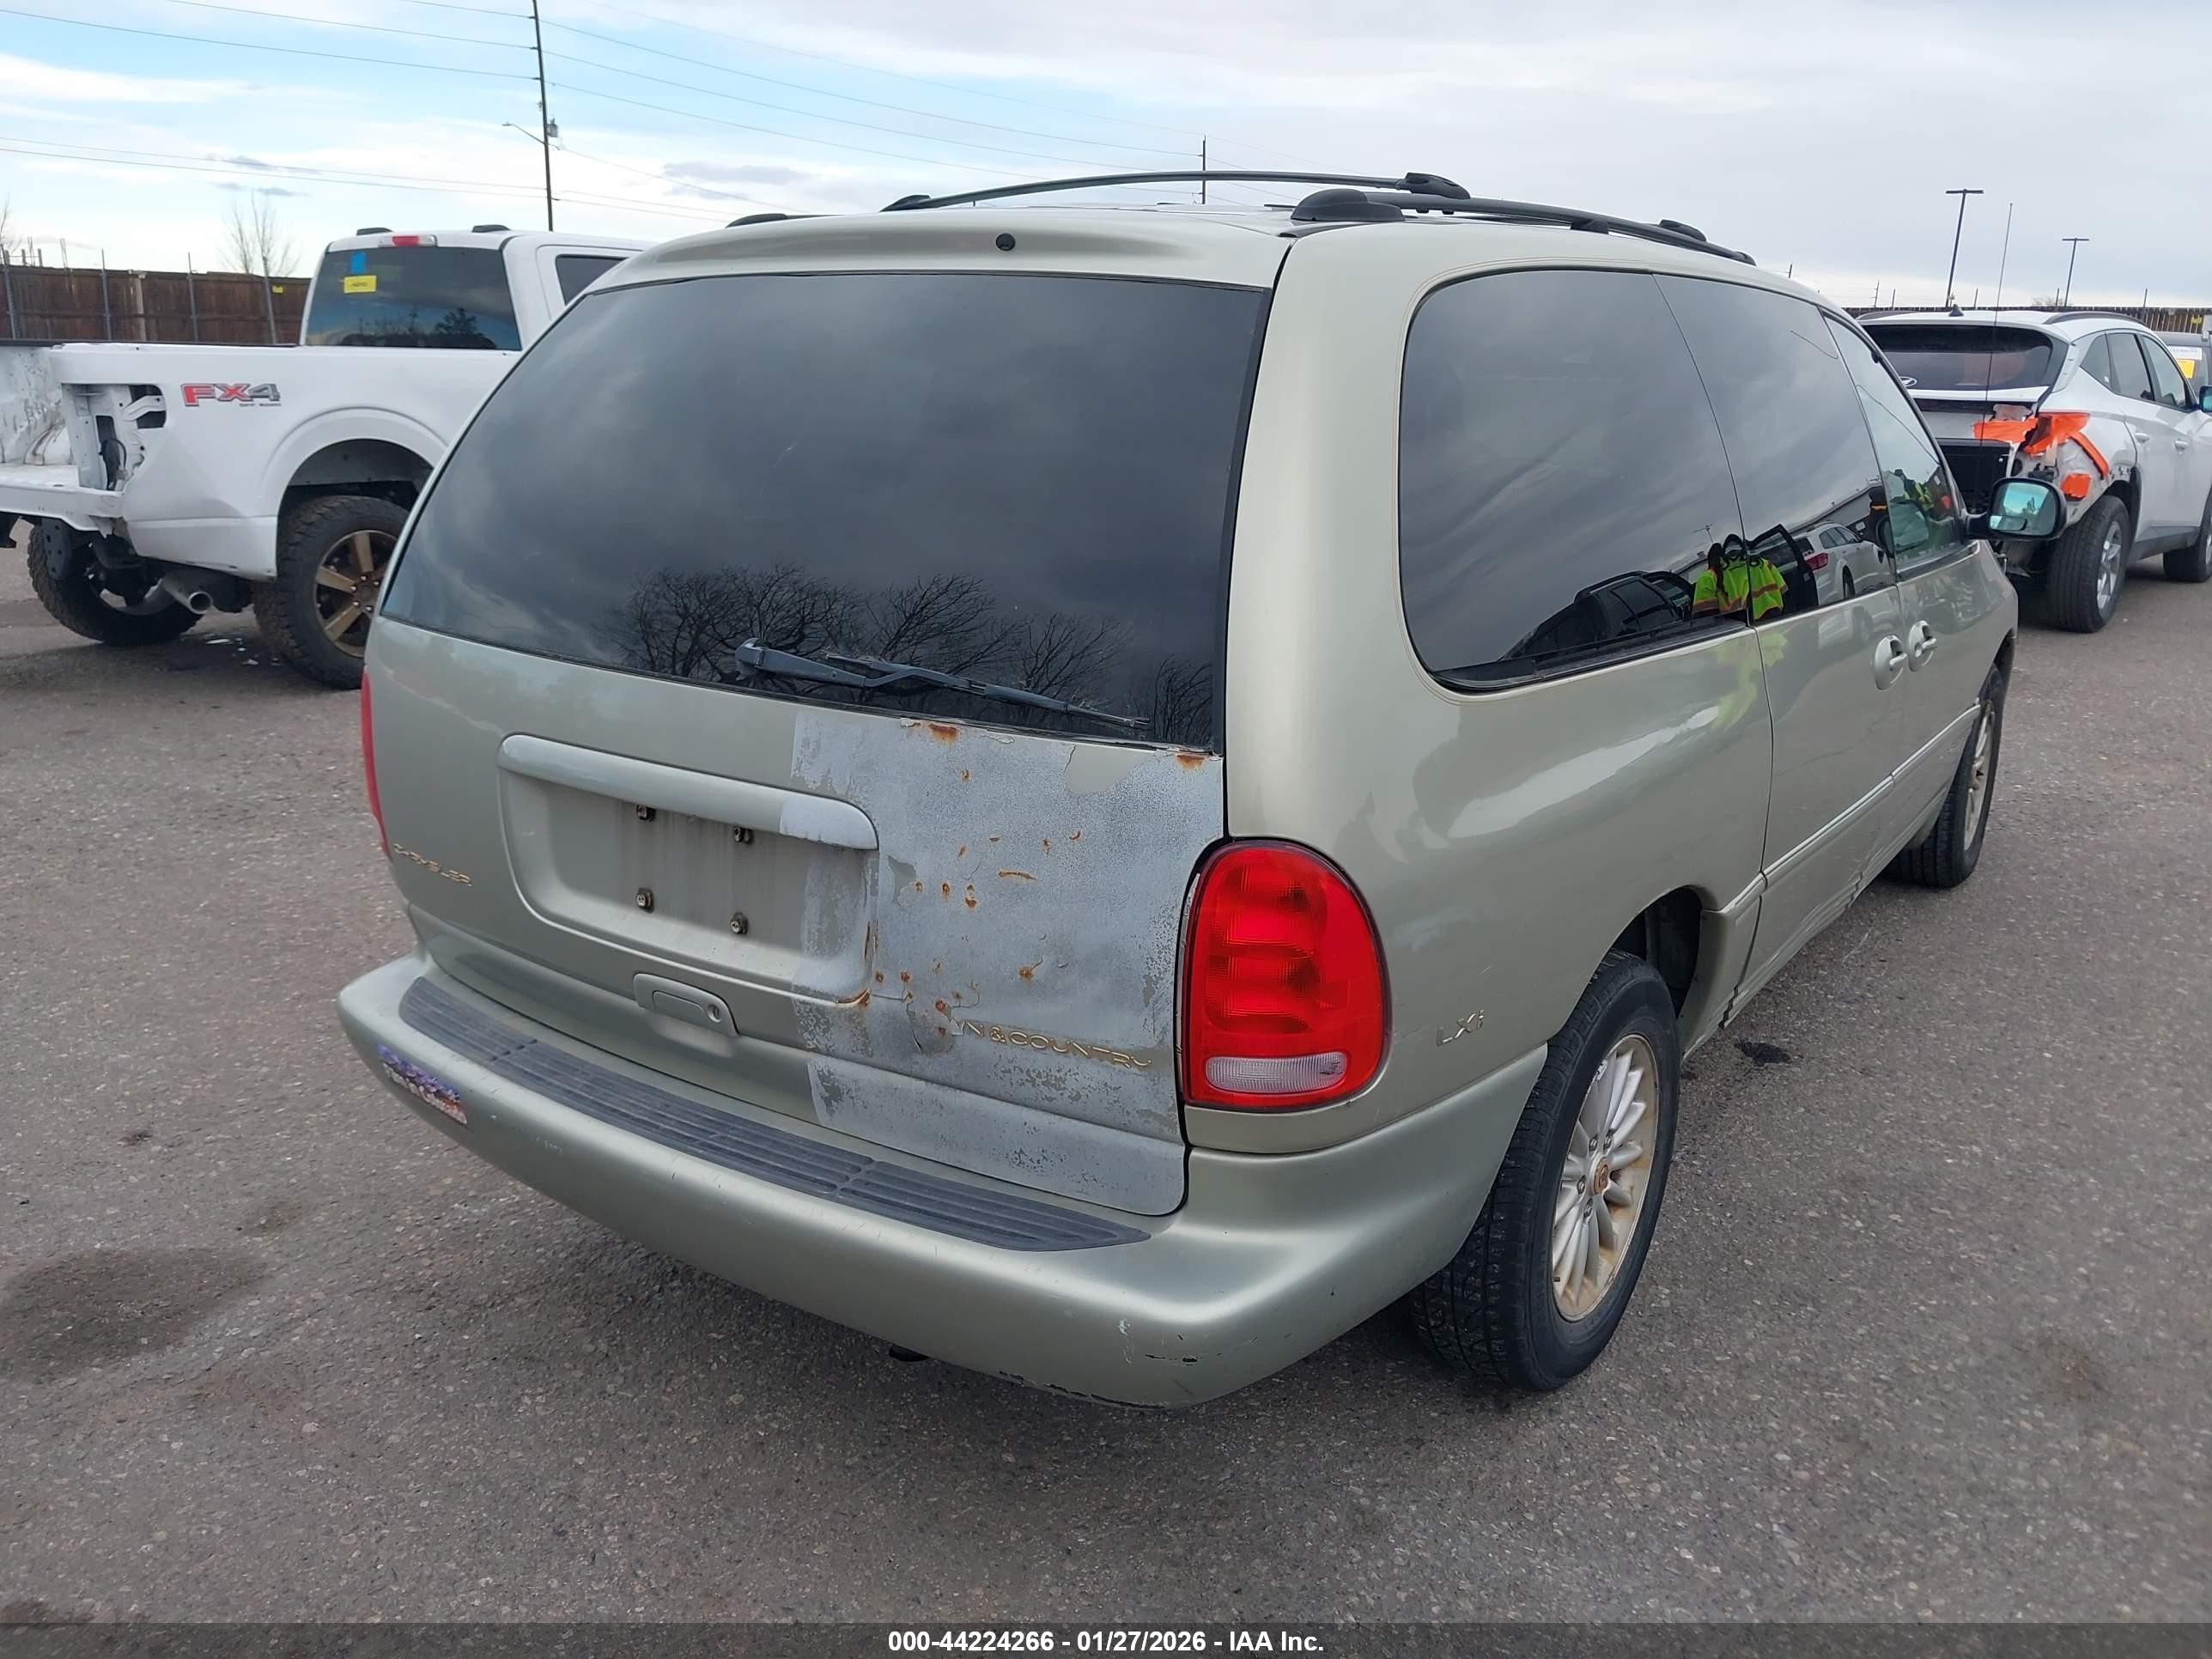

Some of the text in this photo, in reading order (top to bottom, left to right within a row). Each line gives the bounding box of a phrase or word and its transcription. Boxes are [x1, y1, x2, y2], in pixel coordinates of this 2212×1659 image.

[180, 382, 282, 407] FX4
[988, 1025, 1006, 1042] &
[1009, 1030, 1152, 1068] COUNTRY
